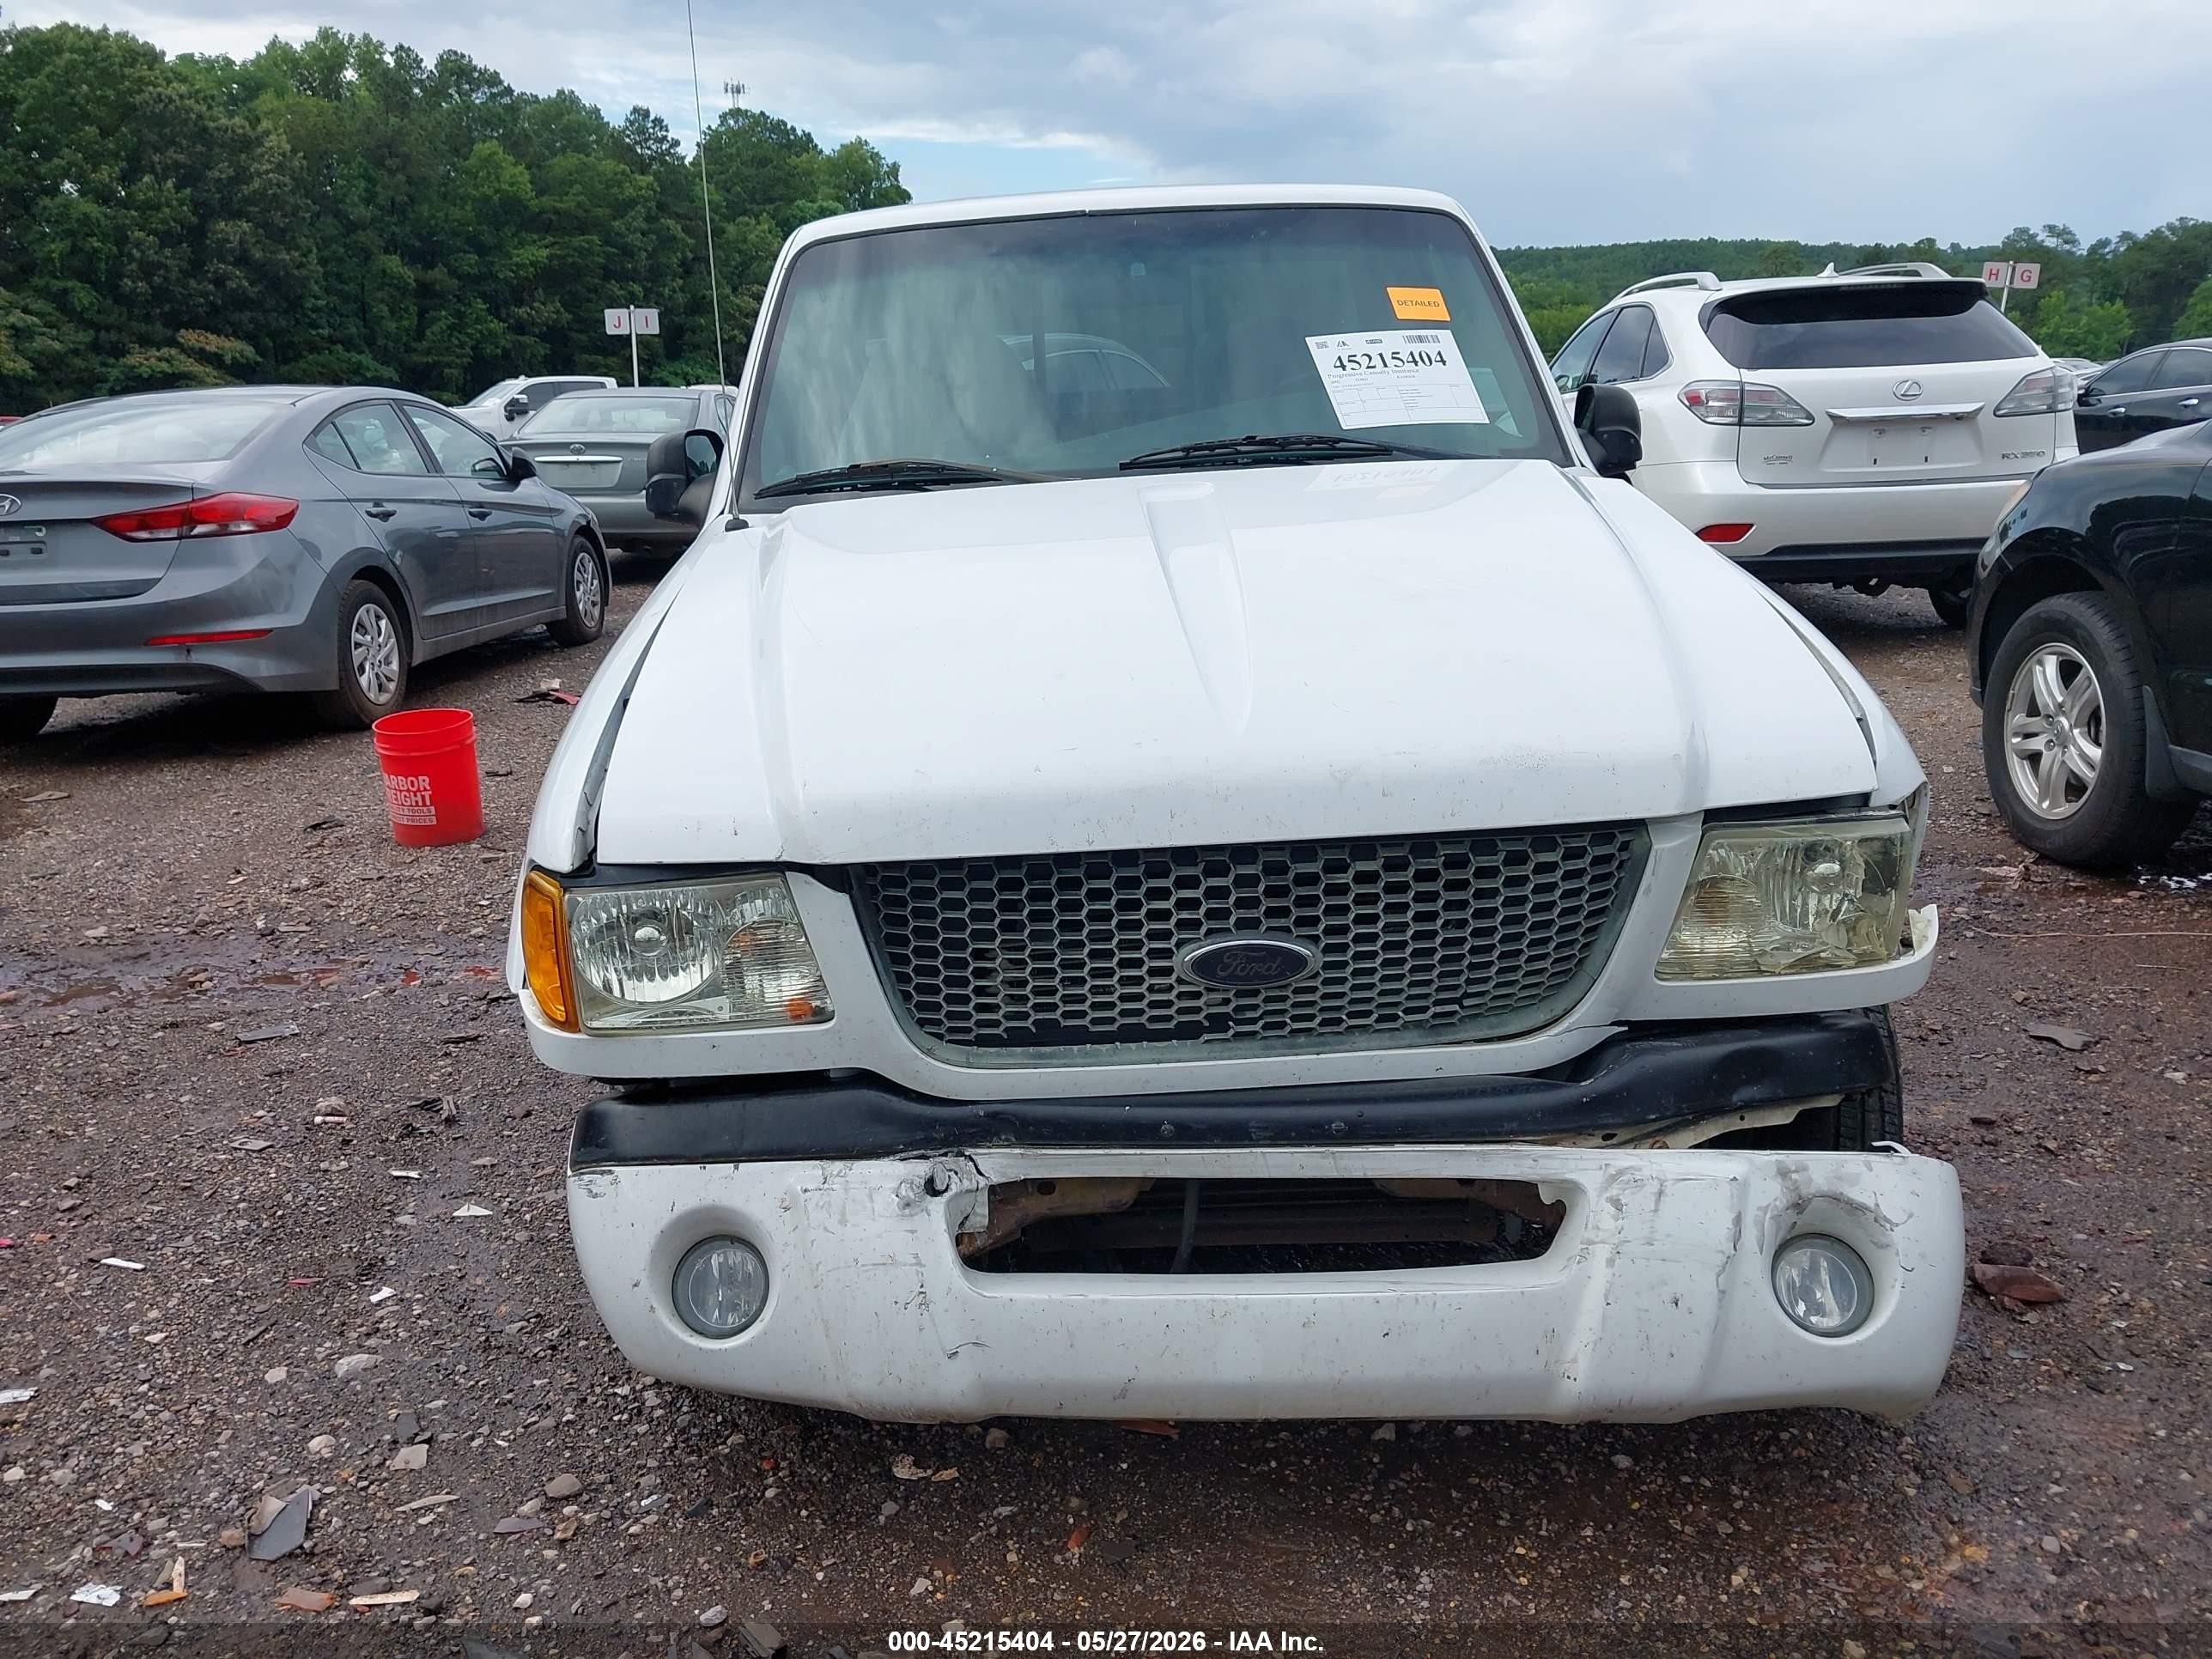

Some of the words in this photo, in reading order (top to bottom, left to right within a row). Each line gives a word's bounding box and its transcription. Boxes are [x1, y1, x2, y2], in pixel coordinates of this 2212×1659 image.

[1989, 268, 1999, 281] H
[2021, 270, 2033, 282] G
[613, 316, 621, 328] J
[1334, 349, 1447, 372] 45215404
[384, 774, 431, 791] ARBOR
[1217, 951, 1282, 977] Ford
